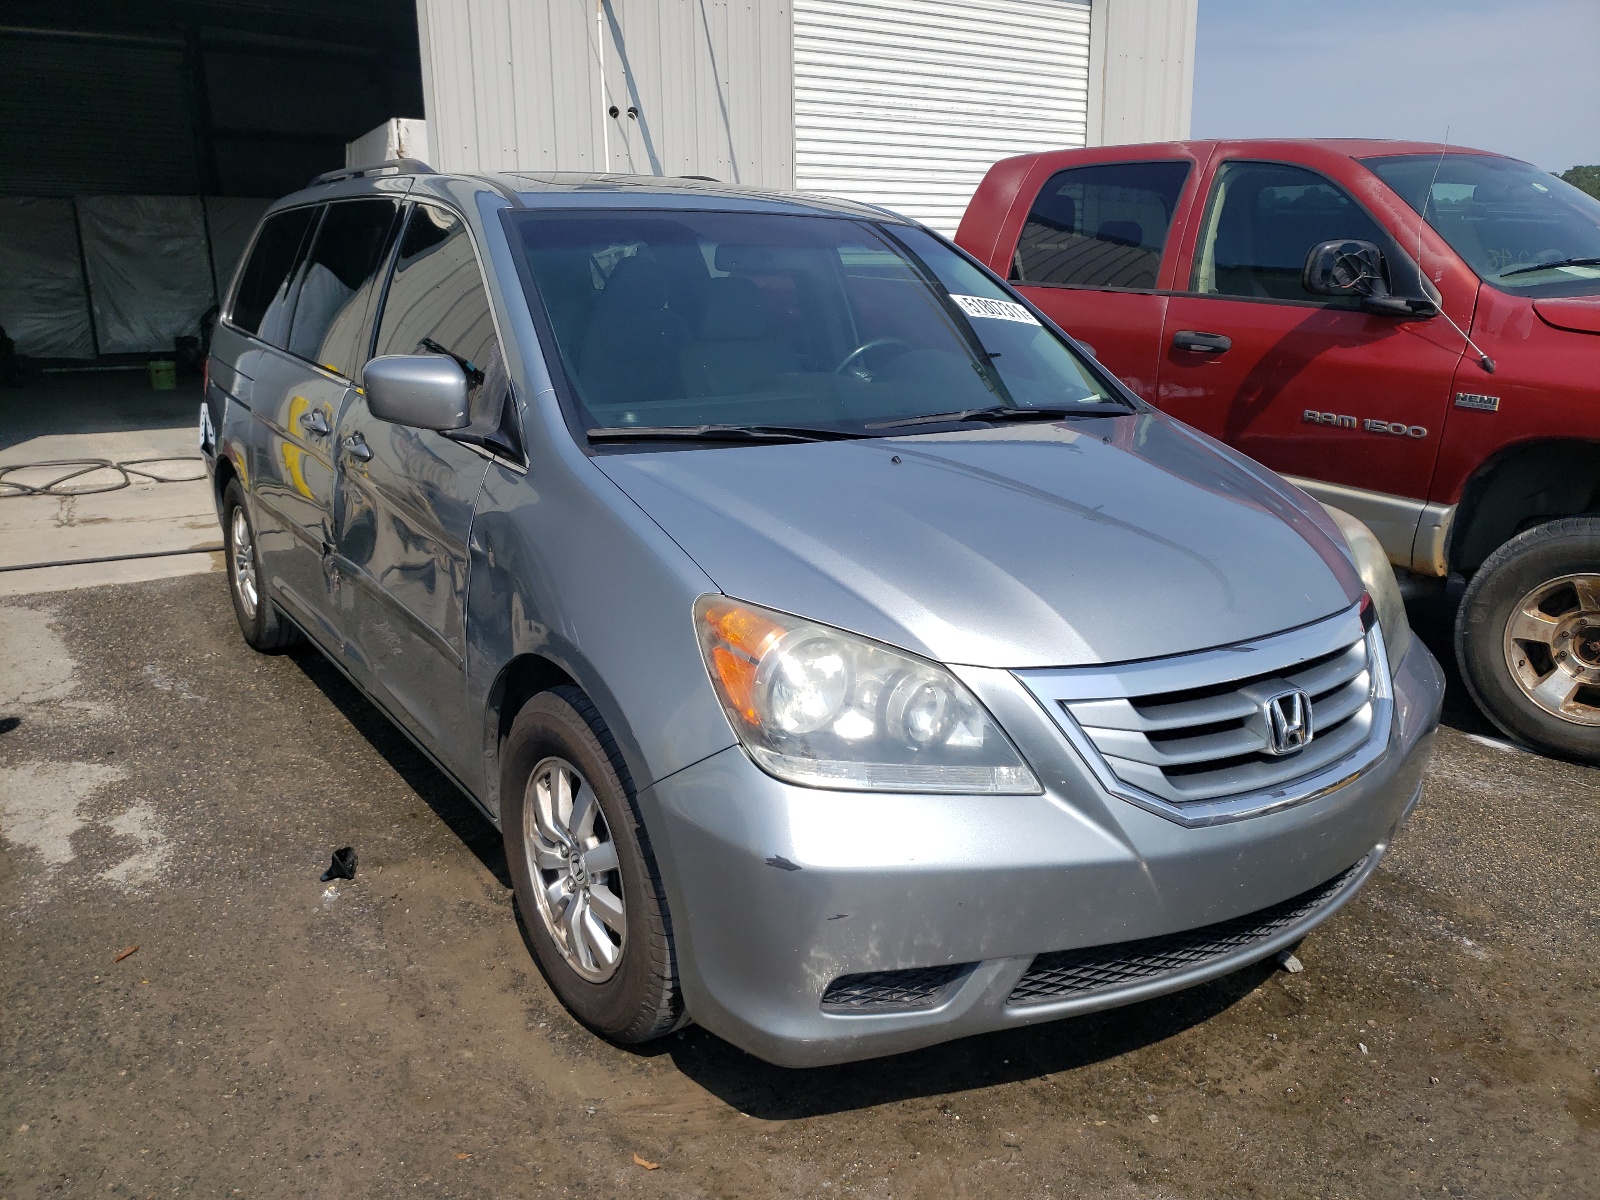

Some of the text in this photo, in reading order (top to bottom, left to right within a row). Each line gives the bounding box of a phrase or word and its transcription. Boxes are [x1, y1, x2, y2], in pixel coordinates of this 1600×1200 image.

[961, 297, 1029, 321] 51807311
[1456, 392, 1499, 406] HEMI
[1303, 409, 1428, 439] RAM 1500
